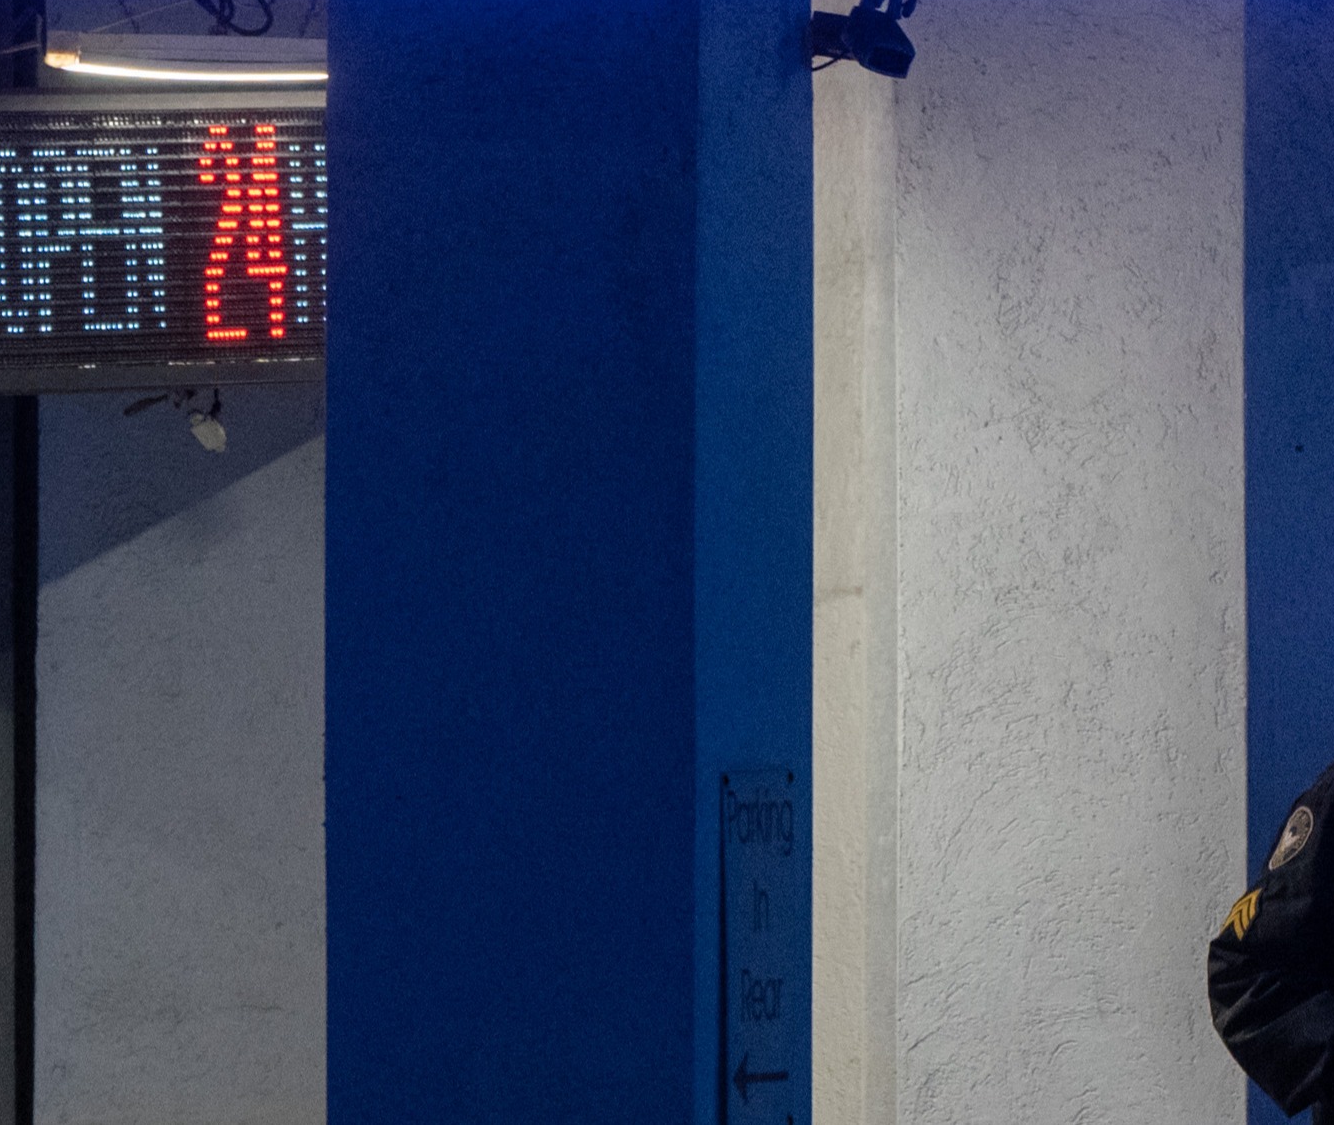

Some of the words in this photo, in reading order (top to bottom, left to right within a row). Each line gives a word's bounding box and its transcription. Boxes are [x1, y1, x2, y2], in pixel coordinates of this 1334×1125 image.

[199, 124, 288, 340] 24
[726, 789, 794, 857] Parking
[739, 969, 784, 1023] Rear
